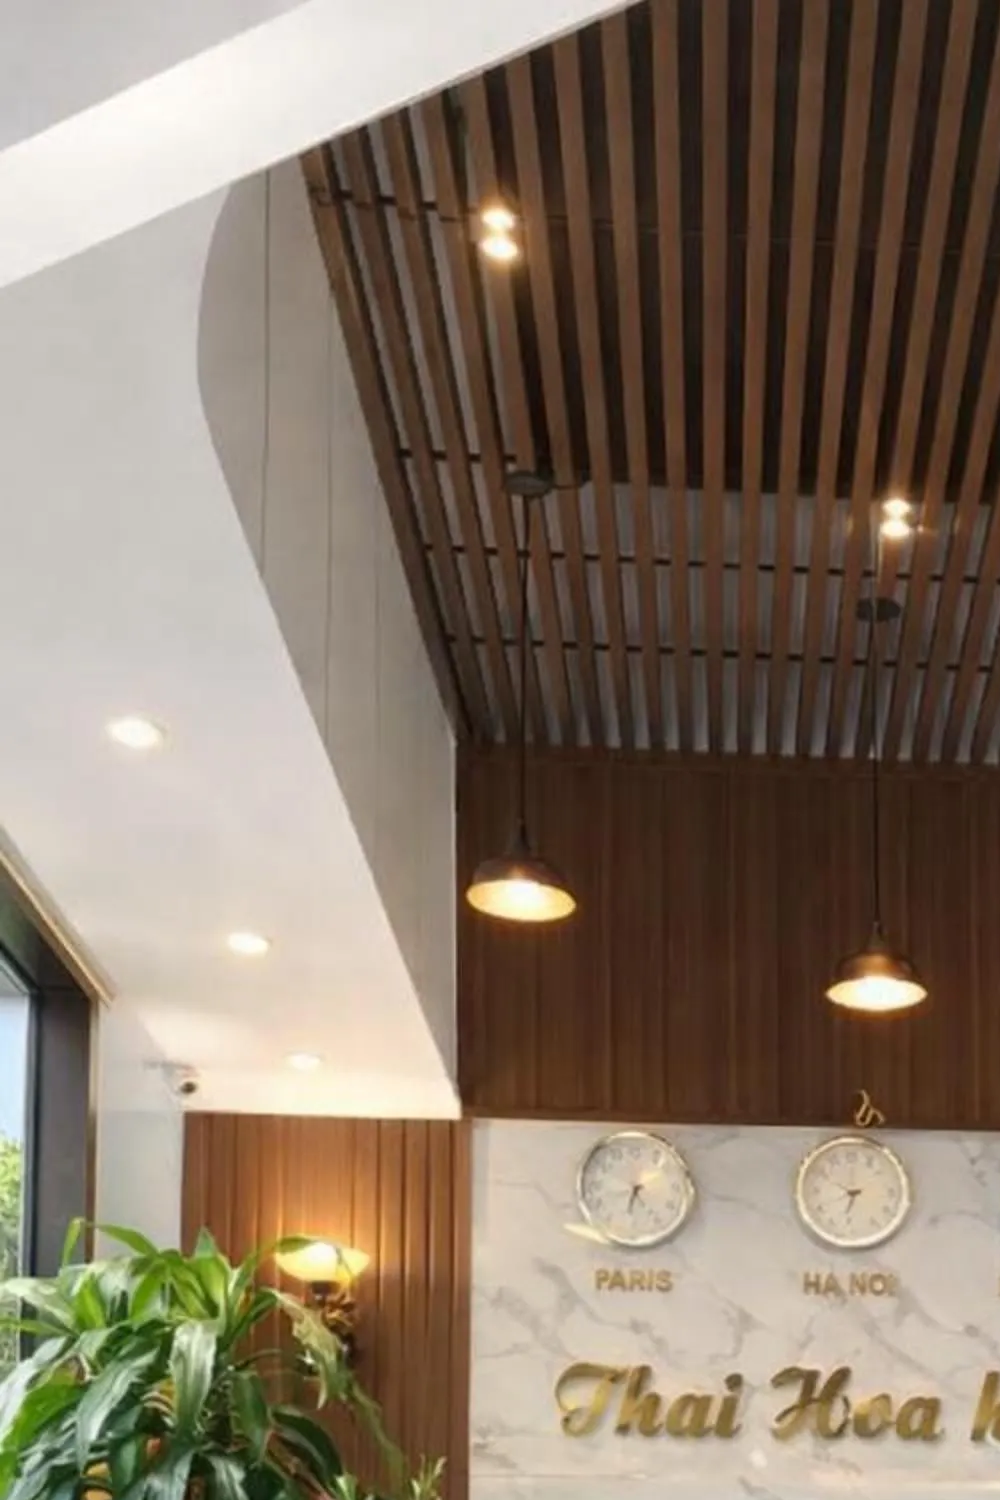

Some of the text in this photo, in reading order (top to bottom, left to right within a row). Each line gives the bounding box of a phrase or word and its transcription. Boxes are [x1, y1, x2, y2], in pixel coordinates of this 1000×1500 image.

[595, 1268, 673, 1292] PARIS
[803, 1272, 842, 1297] HA
[554, 1362, 743, 1439] Thai
[769, 1365, 944, 1442] Hoa
